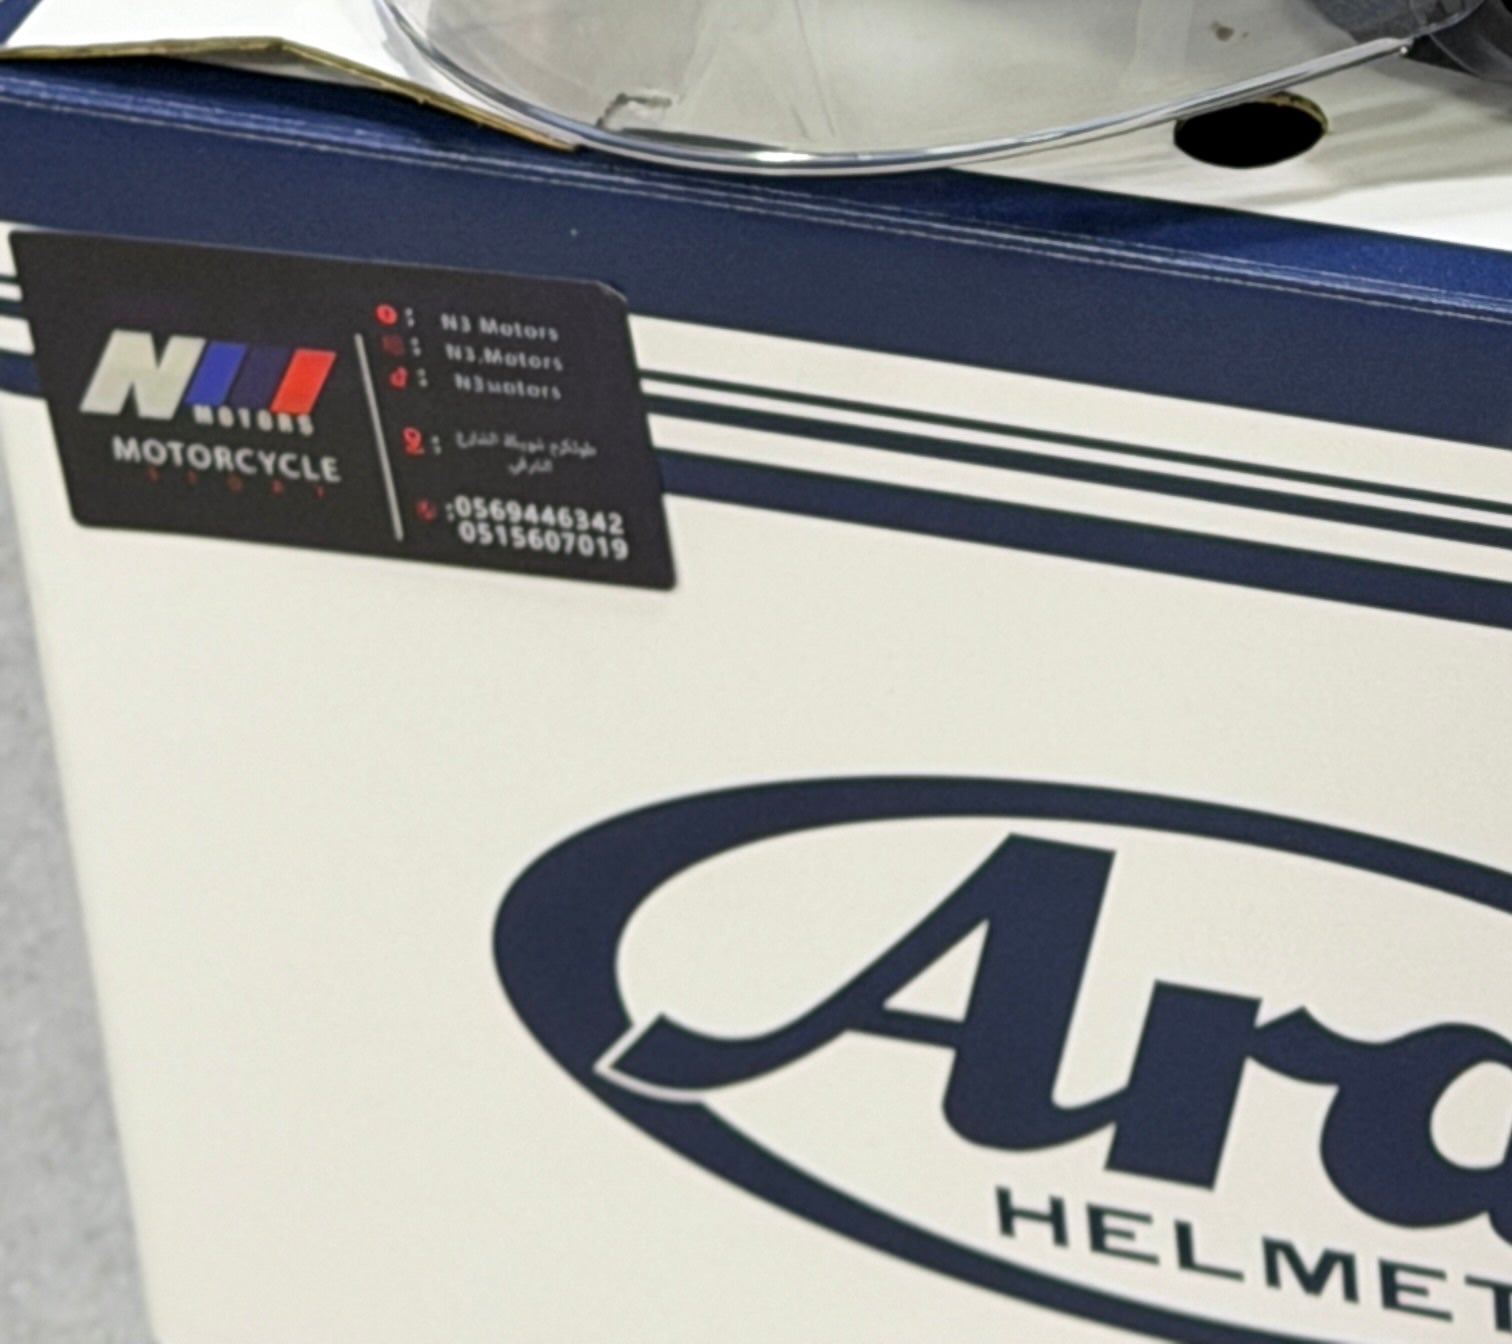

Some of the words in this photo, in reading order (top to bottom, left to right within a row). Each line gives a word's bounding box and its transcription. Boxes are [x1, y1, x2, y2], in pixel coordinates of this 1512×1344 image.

[440, 313, 472, 333] N3
[479, 315, 559, 342] Motors
[112, 435, 342, 483] MOTORCYCLE
[458, 520, 628, 560] 0515607019
